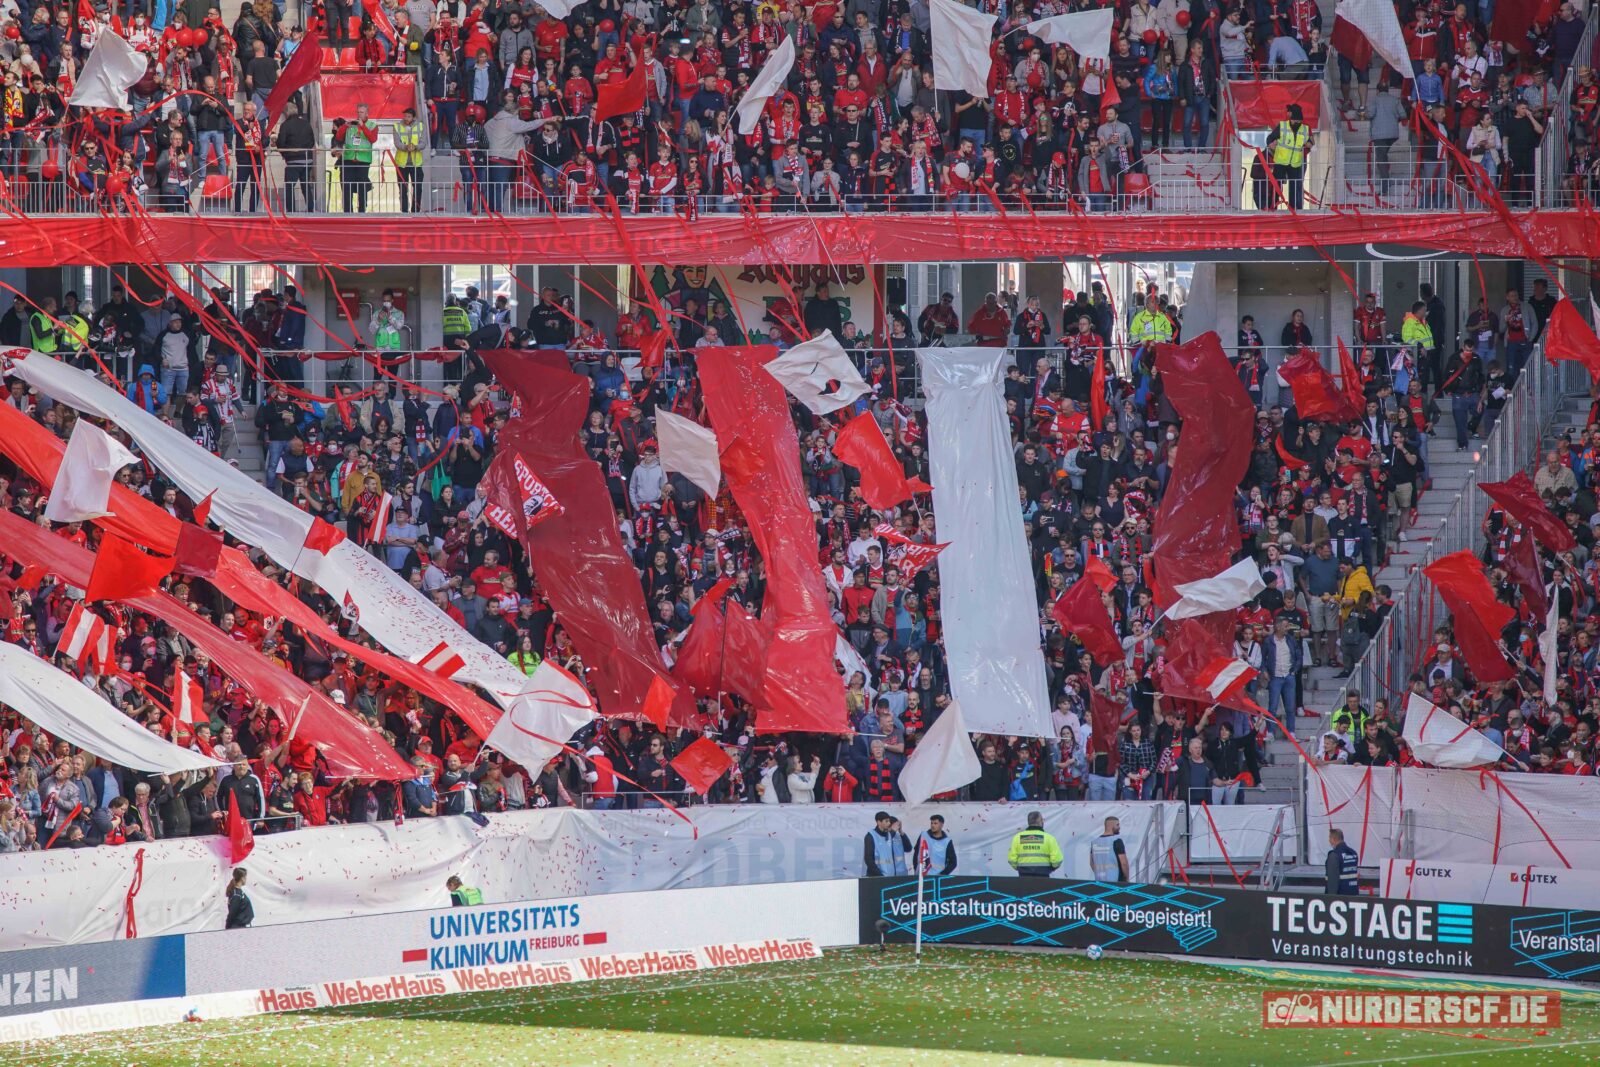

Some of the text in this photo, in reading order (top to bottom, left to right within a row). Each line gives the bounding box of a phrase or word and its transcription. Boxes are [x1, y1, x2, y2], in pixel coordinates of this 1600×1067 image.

[381, 226, 521, 260] Freiburg
[1415, 867, 1452, 878] GUTEX
[1521, 873, 1558, 884] GUTEX
[430, 903, 580, 940] UNIVERSITÄTS
[889, 898, 1212, 929] Veranstaltungstechnik, die begeistert!
[1266, 896, 1433, 942] TECSTAGE
[431, 933, 580, 971] KLINIKUM FREIBURG
[580, 951, 697, 979] WeberHaus
[704, 939, 816, 967] WeberHaus
[1271, 938, 1473, 967] Veranstaltungstechnik
[324, 975, 446, 1006] WeberHaus
[453, 963, 572, 991] WeberHaus
